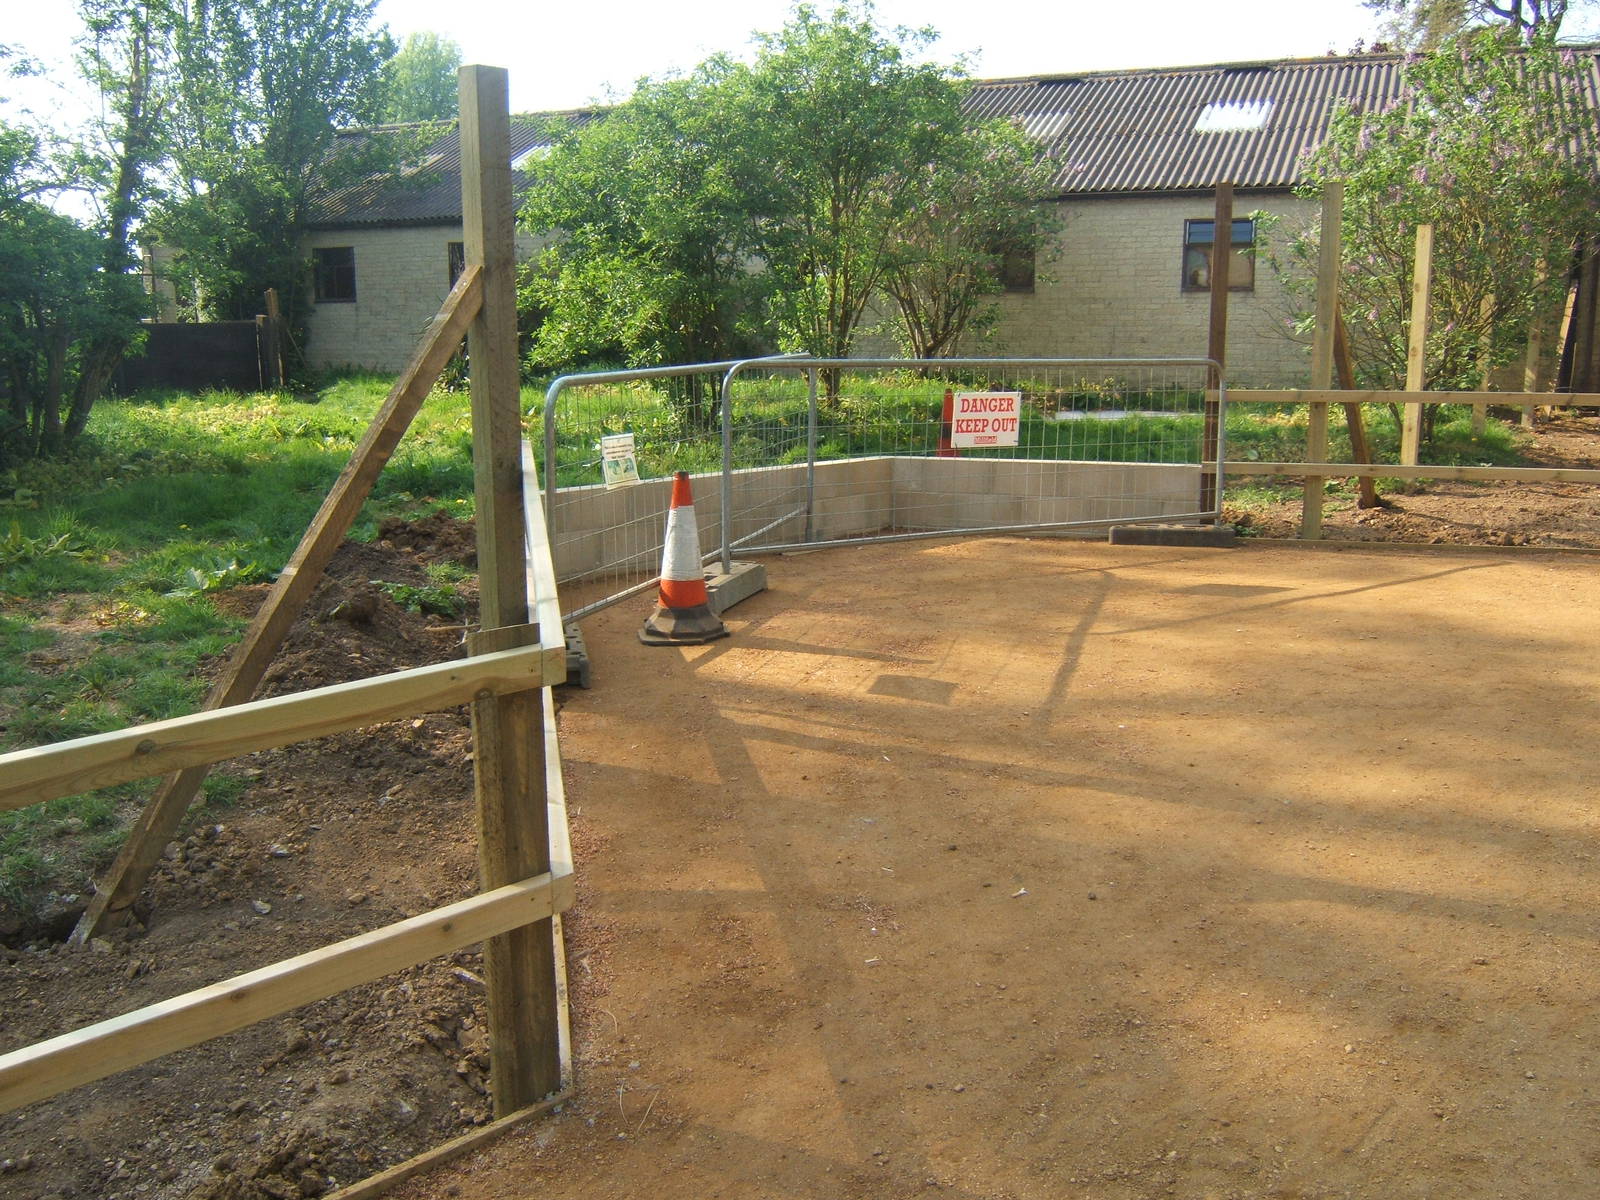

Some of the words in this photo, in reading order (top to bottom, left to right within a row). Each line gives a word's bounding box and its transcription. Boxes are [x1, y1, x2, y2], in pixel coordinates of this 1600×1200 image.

[960, 398, 1014, 413] DANGER
[955, 419, 989, 433] KEEP
[992, 418, 1017, 432] OUT
